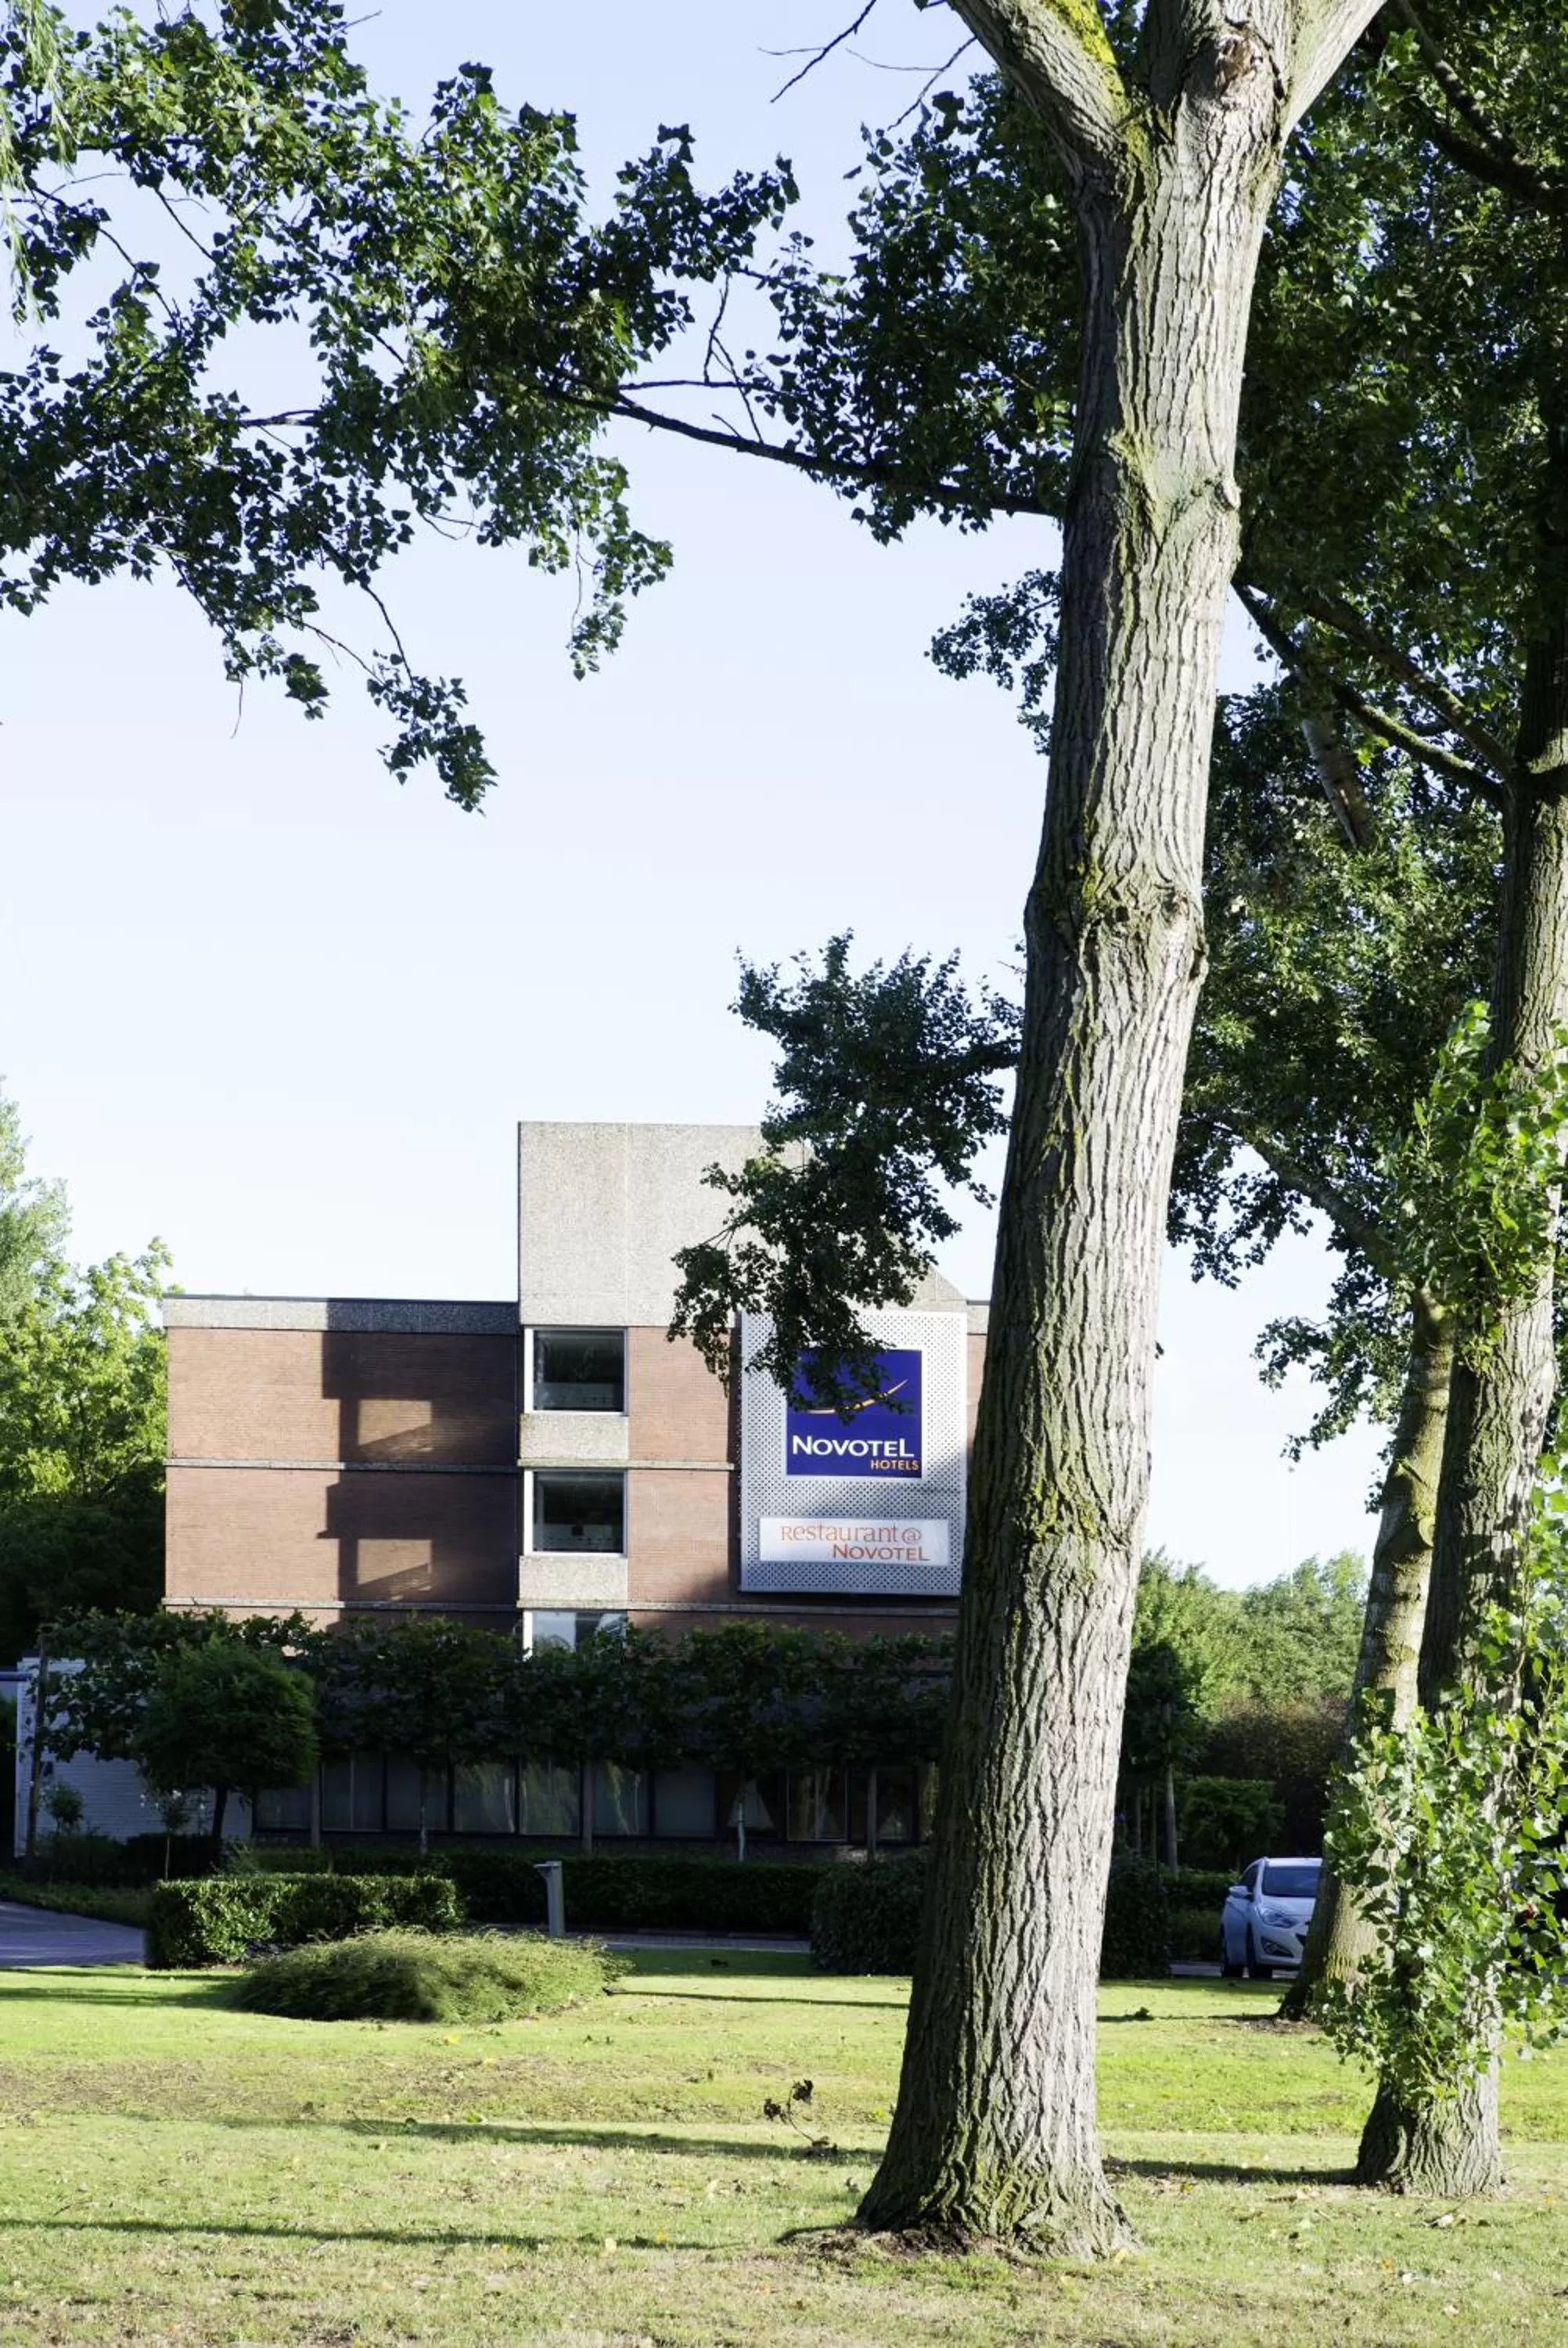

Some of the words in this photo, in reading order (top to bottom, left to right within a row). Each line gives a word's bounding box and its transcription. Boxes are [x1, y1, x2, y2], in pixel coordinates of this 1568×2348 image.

[793, 1435, 914, 1457] NOVOTEL
[870, 1460, 919, 1471] HOTELS
[833, 1544, 930, 1561] NOVOTEL
